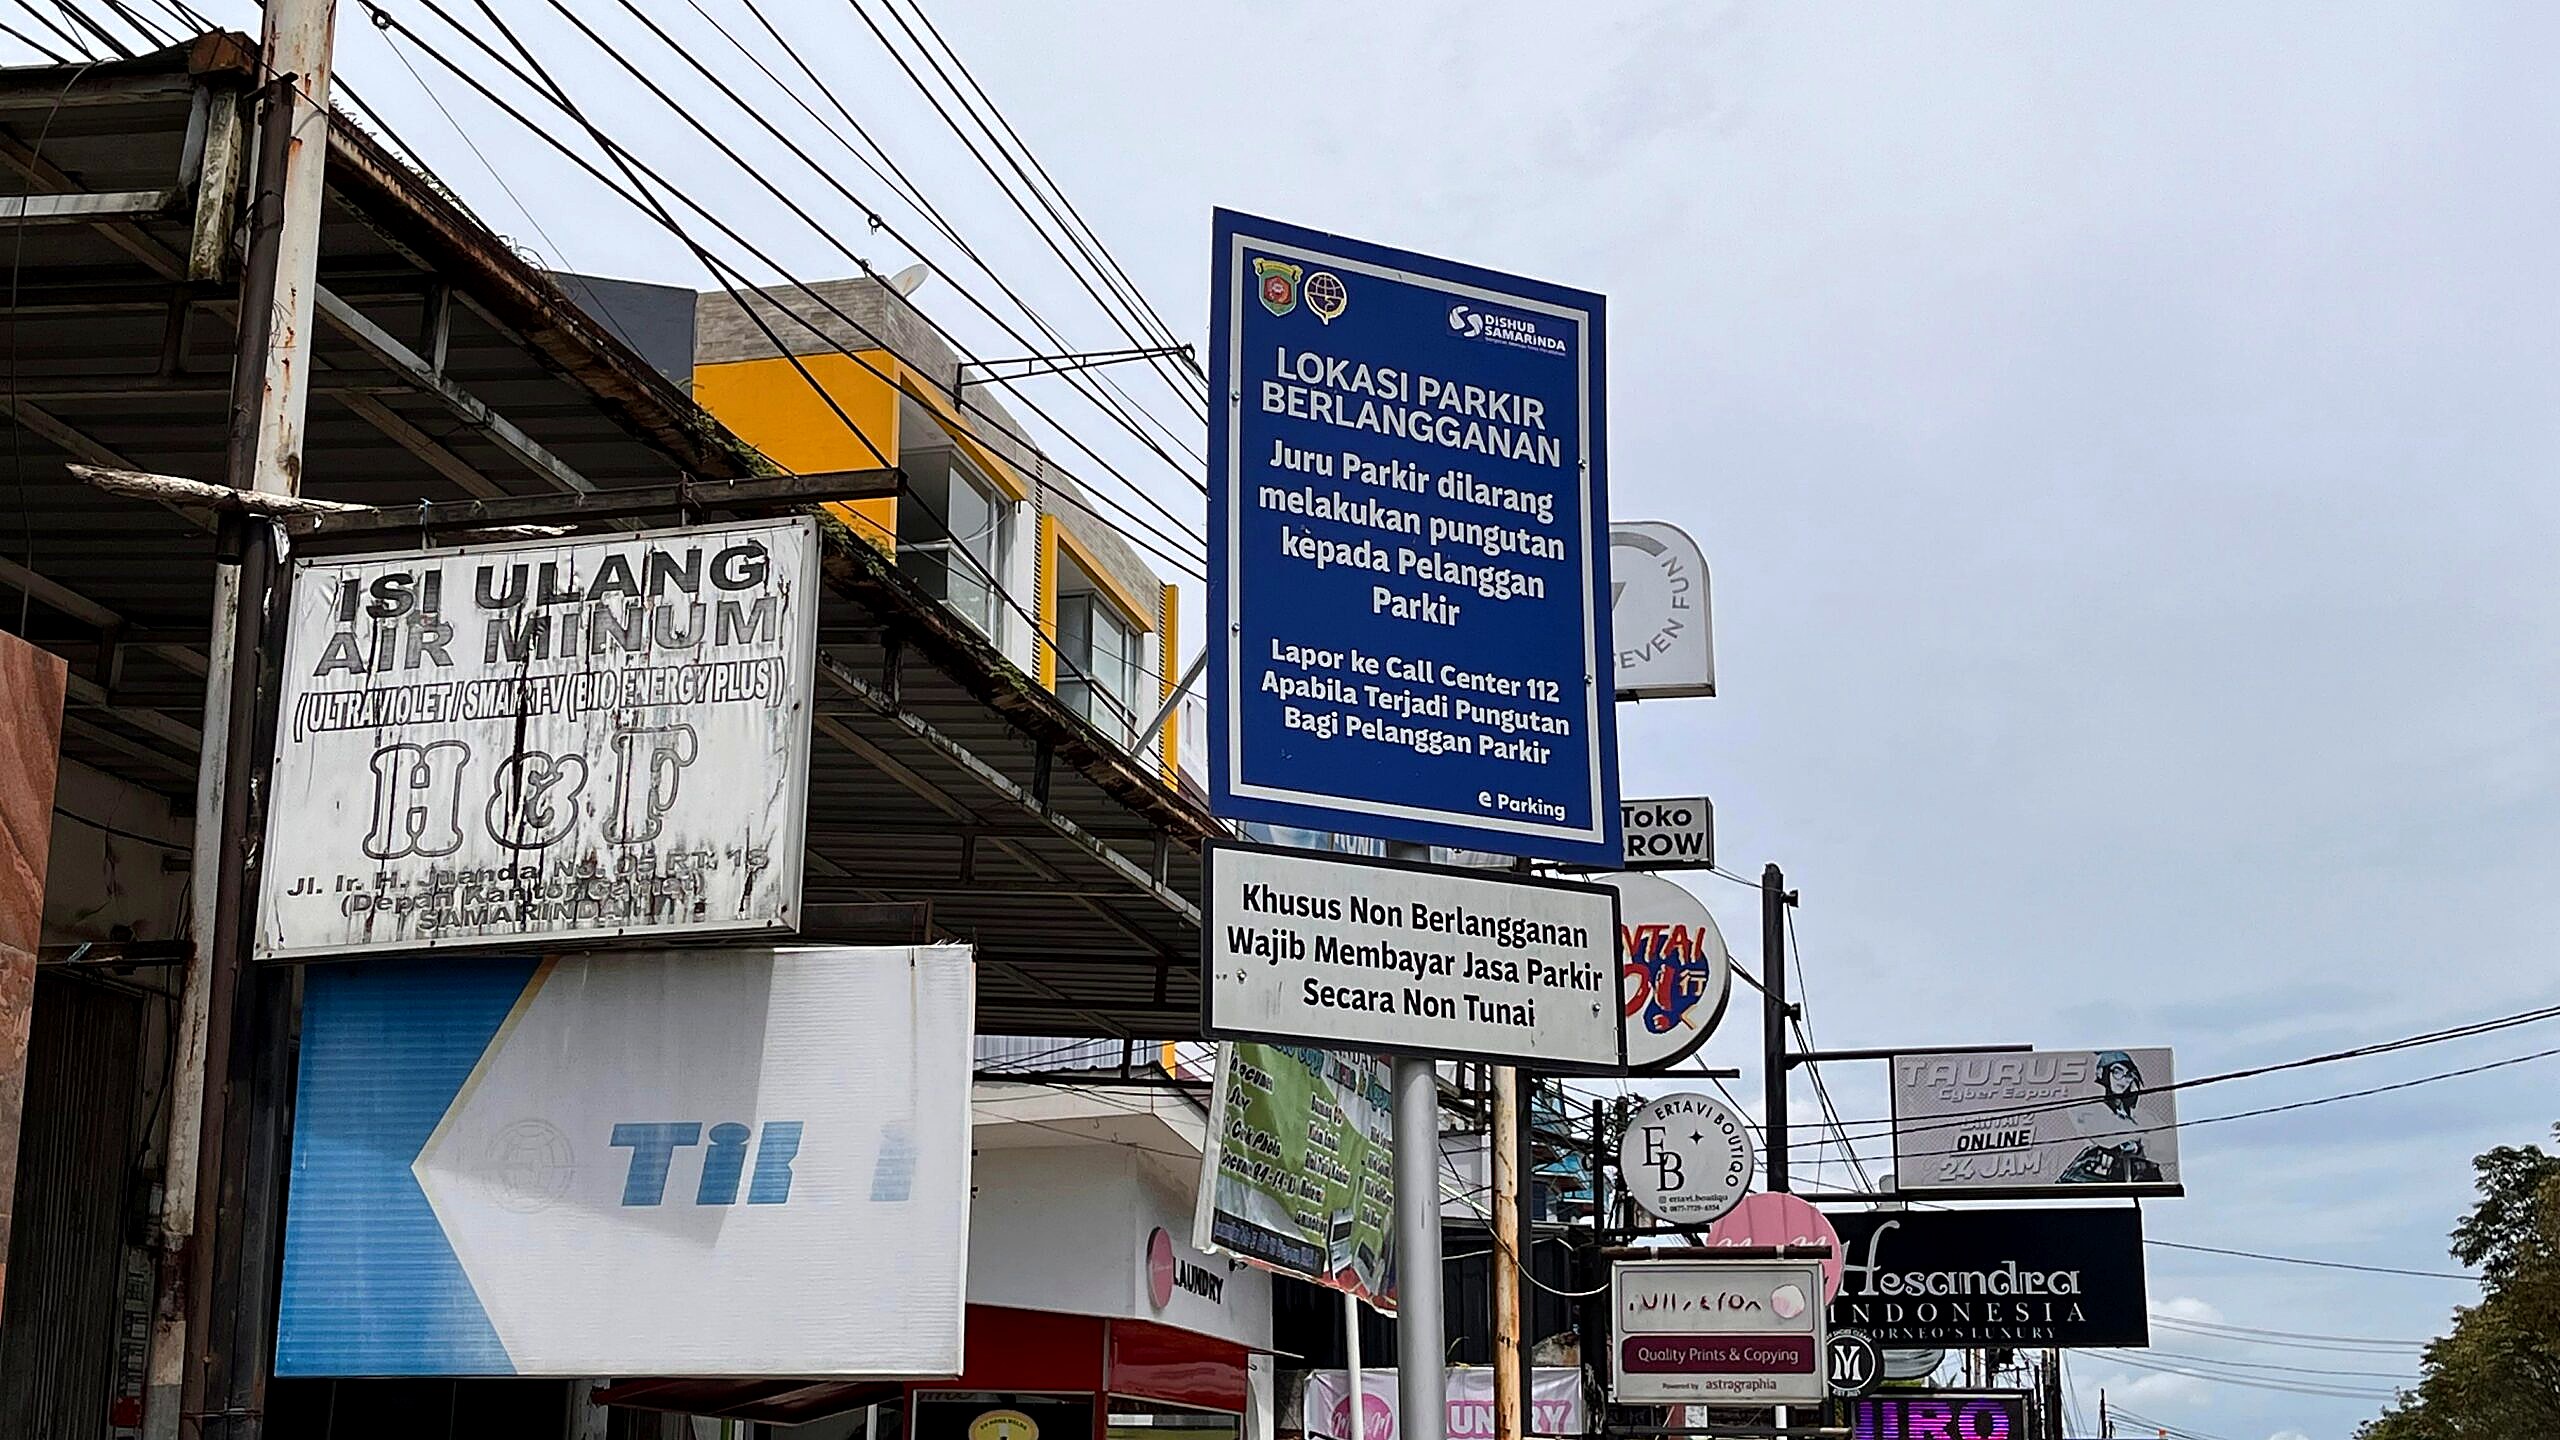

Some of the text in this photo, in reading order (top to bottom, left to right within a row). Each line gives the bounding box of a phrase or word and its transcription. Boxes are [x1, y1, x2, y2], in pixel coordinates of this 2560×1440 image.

[1485, 314, 1535, 333] DISHUB
[1485, 326, 1566, 351] SAMARINDA
[1277, 347, 1545, 430] LOKASI PARKIR
[1262, 380, 1561, 467] BERLANGGANAN
[1270, 440, 1554, 524] Juru Parkir dilarang
[1259, 485, 1565, 561] melakukan pungutan
[339, 539, 769, 623] ISI ULANG
[1282, 527, 1545, 600] kepada Pelanggan
[1373, 586, 1461, 627] Parkir
[1615, 556, 1690, 669] EVEN FUN
[313, 595, 779, 677] AIR MINUM
[620, 664, 712, 708] ENERGY
[1271, 638, 1560, 703] Lapor ke Call Center 112
[1261, 670, 1570, 737] Apabila Terjadi Pungutan
[1284, 706, 1551, 765] Bagi Pelanggan Parkir
[1478, 790, 1566, 821] e Parking
[1622, 805, 1692, 828] Toko
[287, 877, 323, 896] Jl.
[335, 874, 362, 892] Ir.
[374, 871, 409, 889] H.
[417, 862, 539, 888] Juanda
[341, 888, 455, 918] (Depan
[465, 879, 578, 906] Kantor
[1243, 883, 1588, 950] Khusus Non Berlangganan
[1227, 926, 1603, 993] Wajib Membayar Jasa Parkir
[1302, 977, 1537, 1028] Secara Non Tunai
[1900, 1055, 2088, 1088] TAURUS
[1654, 1101, 1714, 1121] ERTAVI
[1939, 1087, 1998, 1104] Cyber
[1957, 1130, 2032, 1151] ONLINE
[1939, 1151, 2044, 1182] 24 JAM
[1173, 1256, 1225, 1305] LAUNDRY
[1830, 1302, 2088, 1323] INDONESIA
[1638, 1347, 1799, 1365] Quality Prints & Copying
[1705, 1378, 1777, 1393] astragraphia
